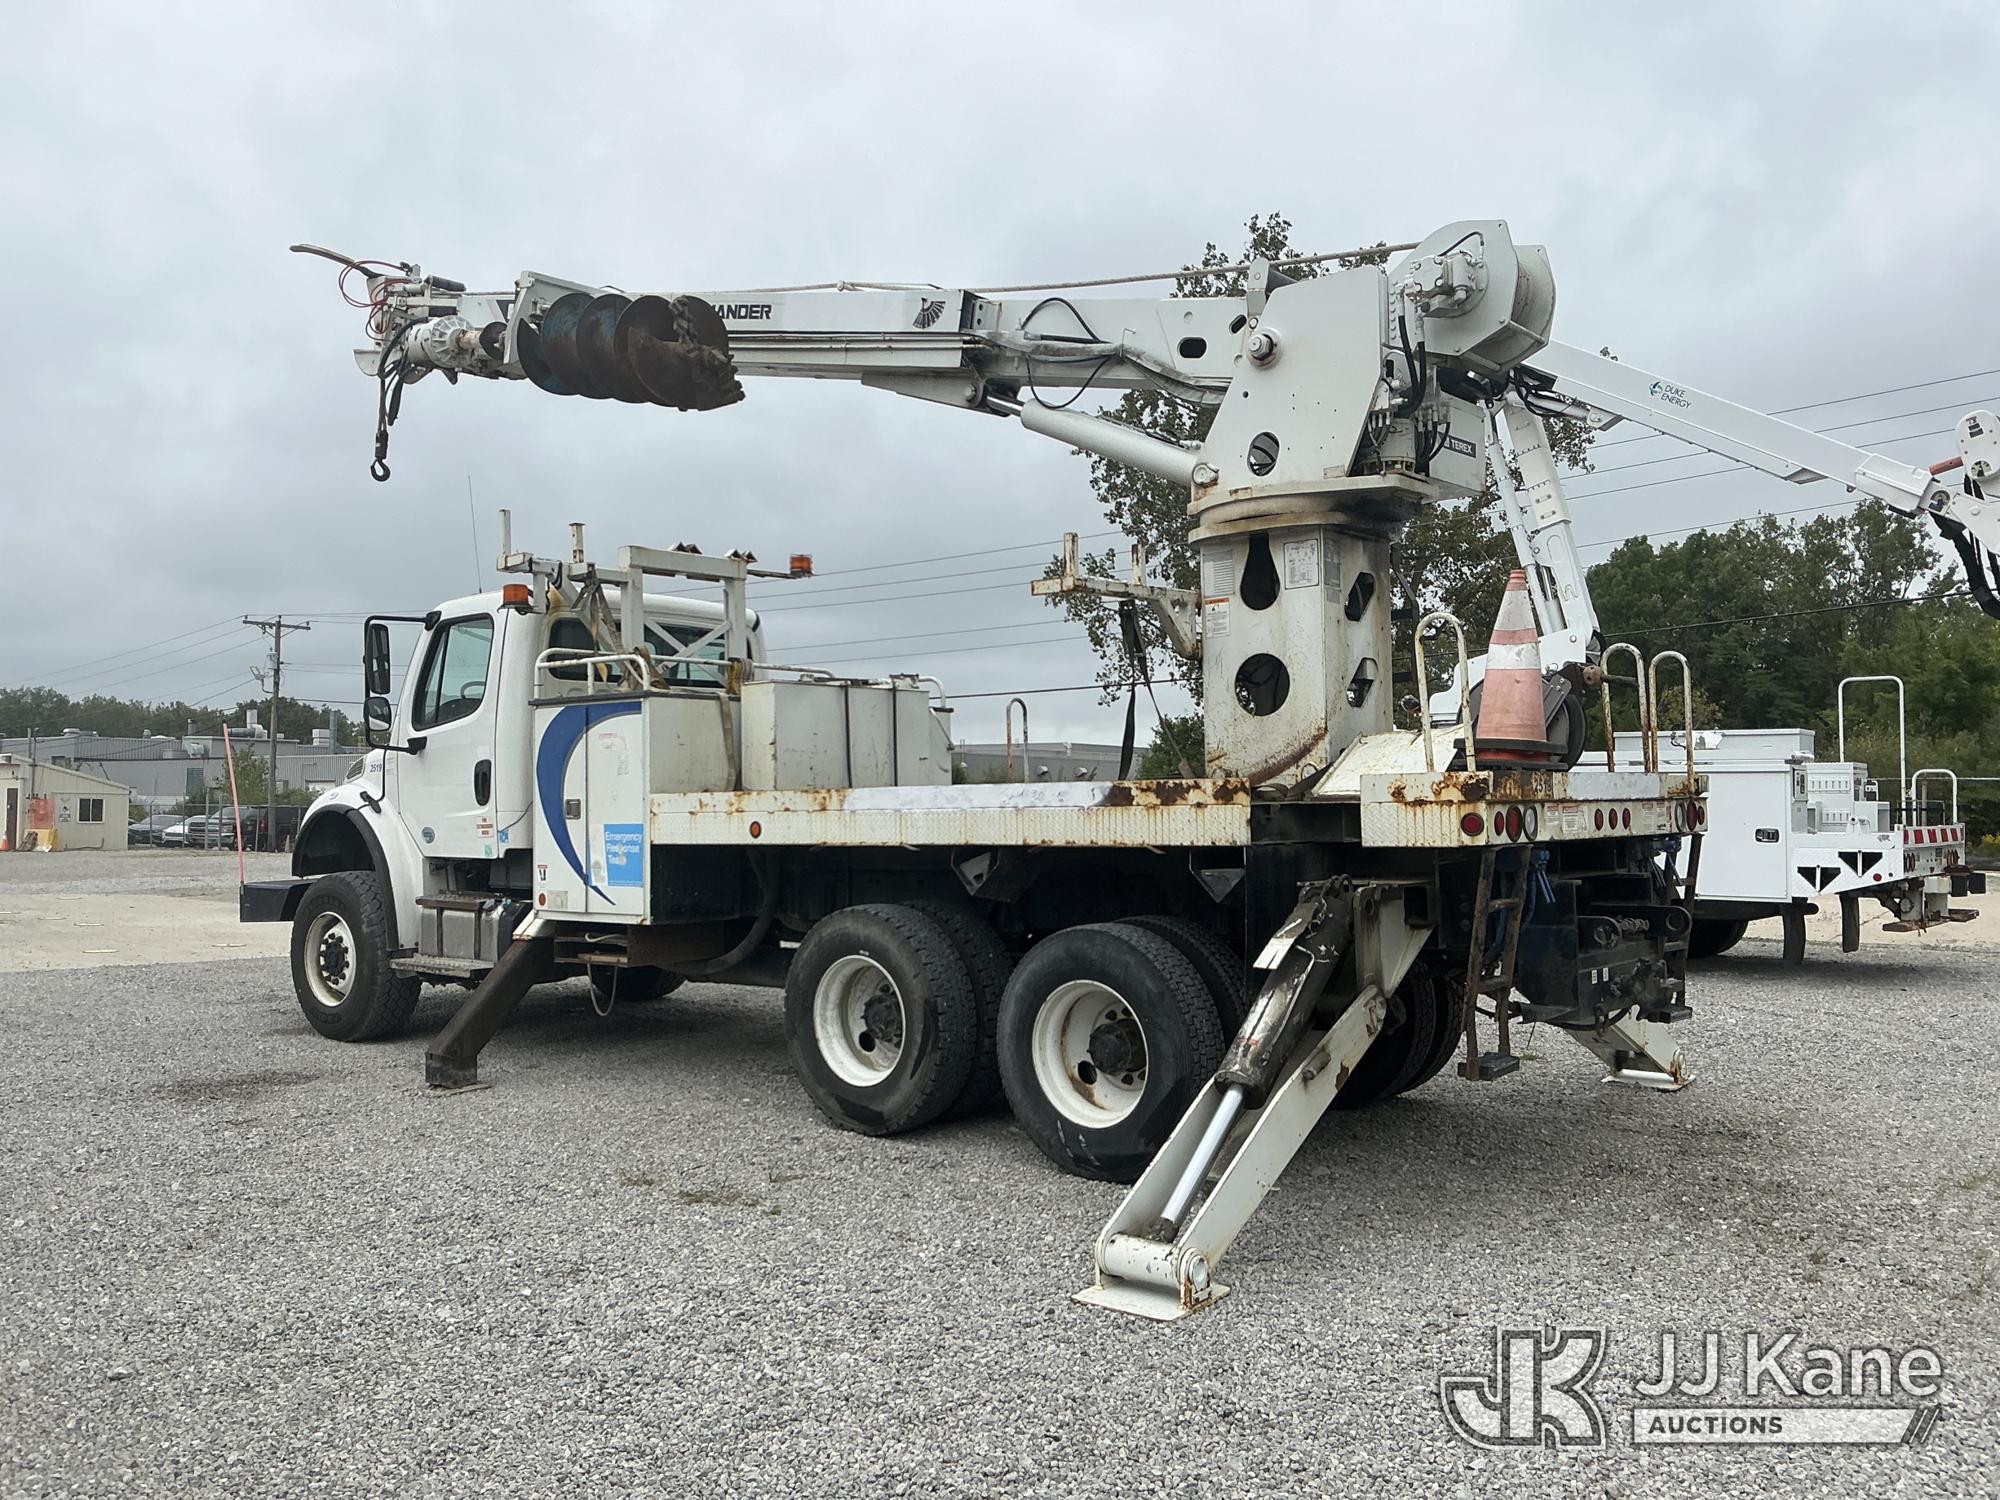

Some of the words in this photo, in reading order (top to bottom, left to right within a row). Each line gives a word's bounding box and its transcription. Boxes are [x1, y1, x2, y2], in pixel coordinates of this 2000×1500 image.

[712, 304, 772, 320] ANDER
[1664, 384, 1686, 398] DUKE
[1660, 392, 1692, 409] ENERGY
[1450, 439, 1473, 454] TEREX
[605, 831, 642, 844] Emergency
